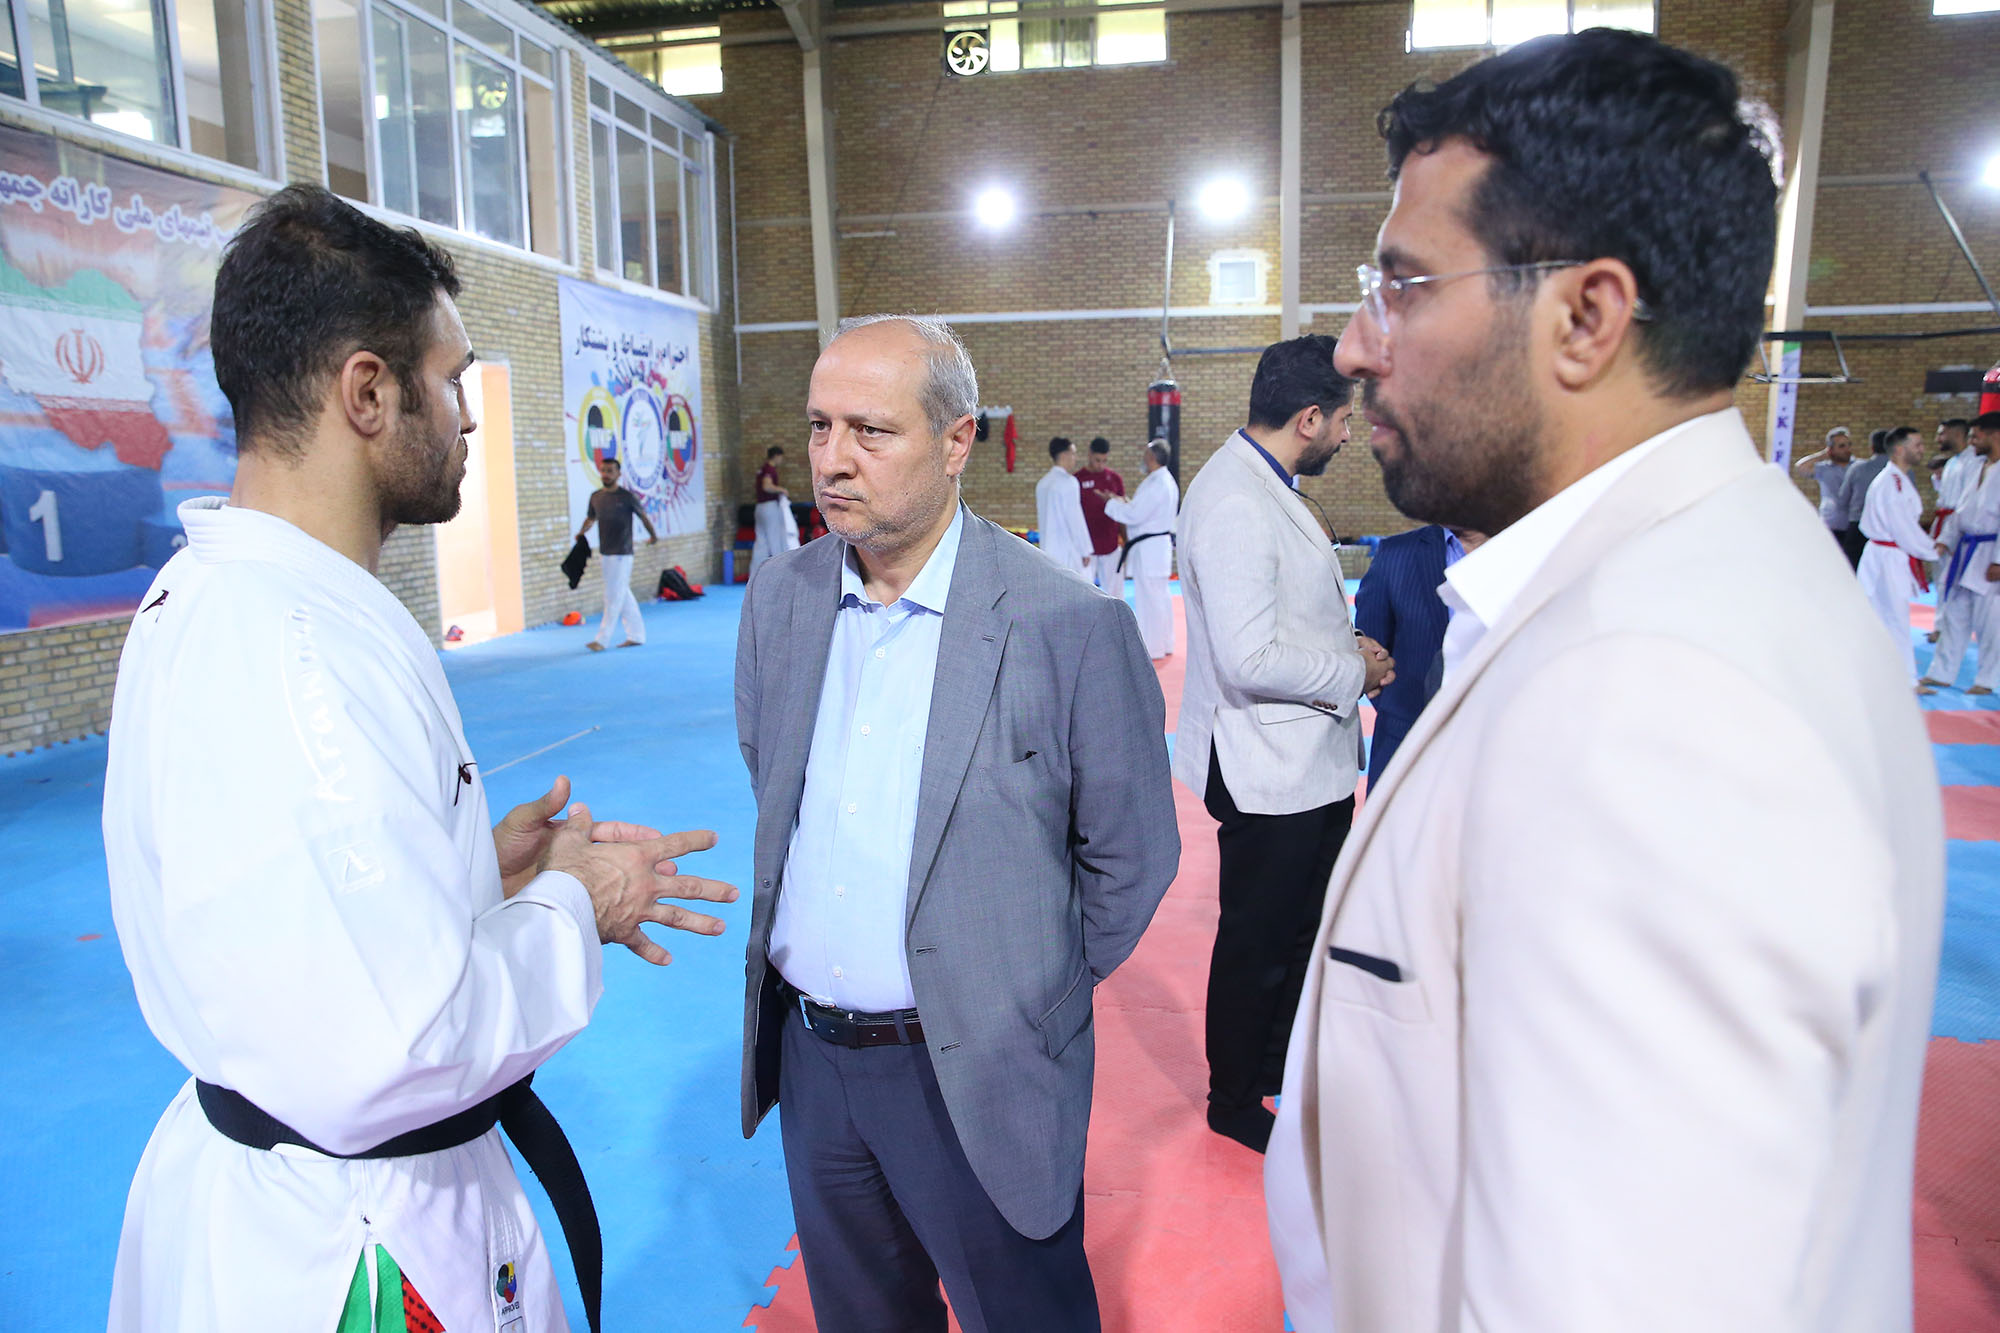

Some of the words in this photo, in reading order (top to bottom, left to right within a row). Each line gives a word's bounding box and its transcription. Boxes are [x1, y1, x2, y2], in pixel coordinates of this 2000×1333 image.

[50, 178, 110, 222] کاراته
[115, 197, 153, 231] ملی
[29, 490, 63, 562] 1
